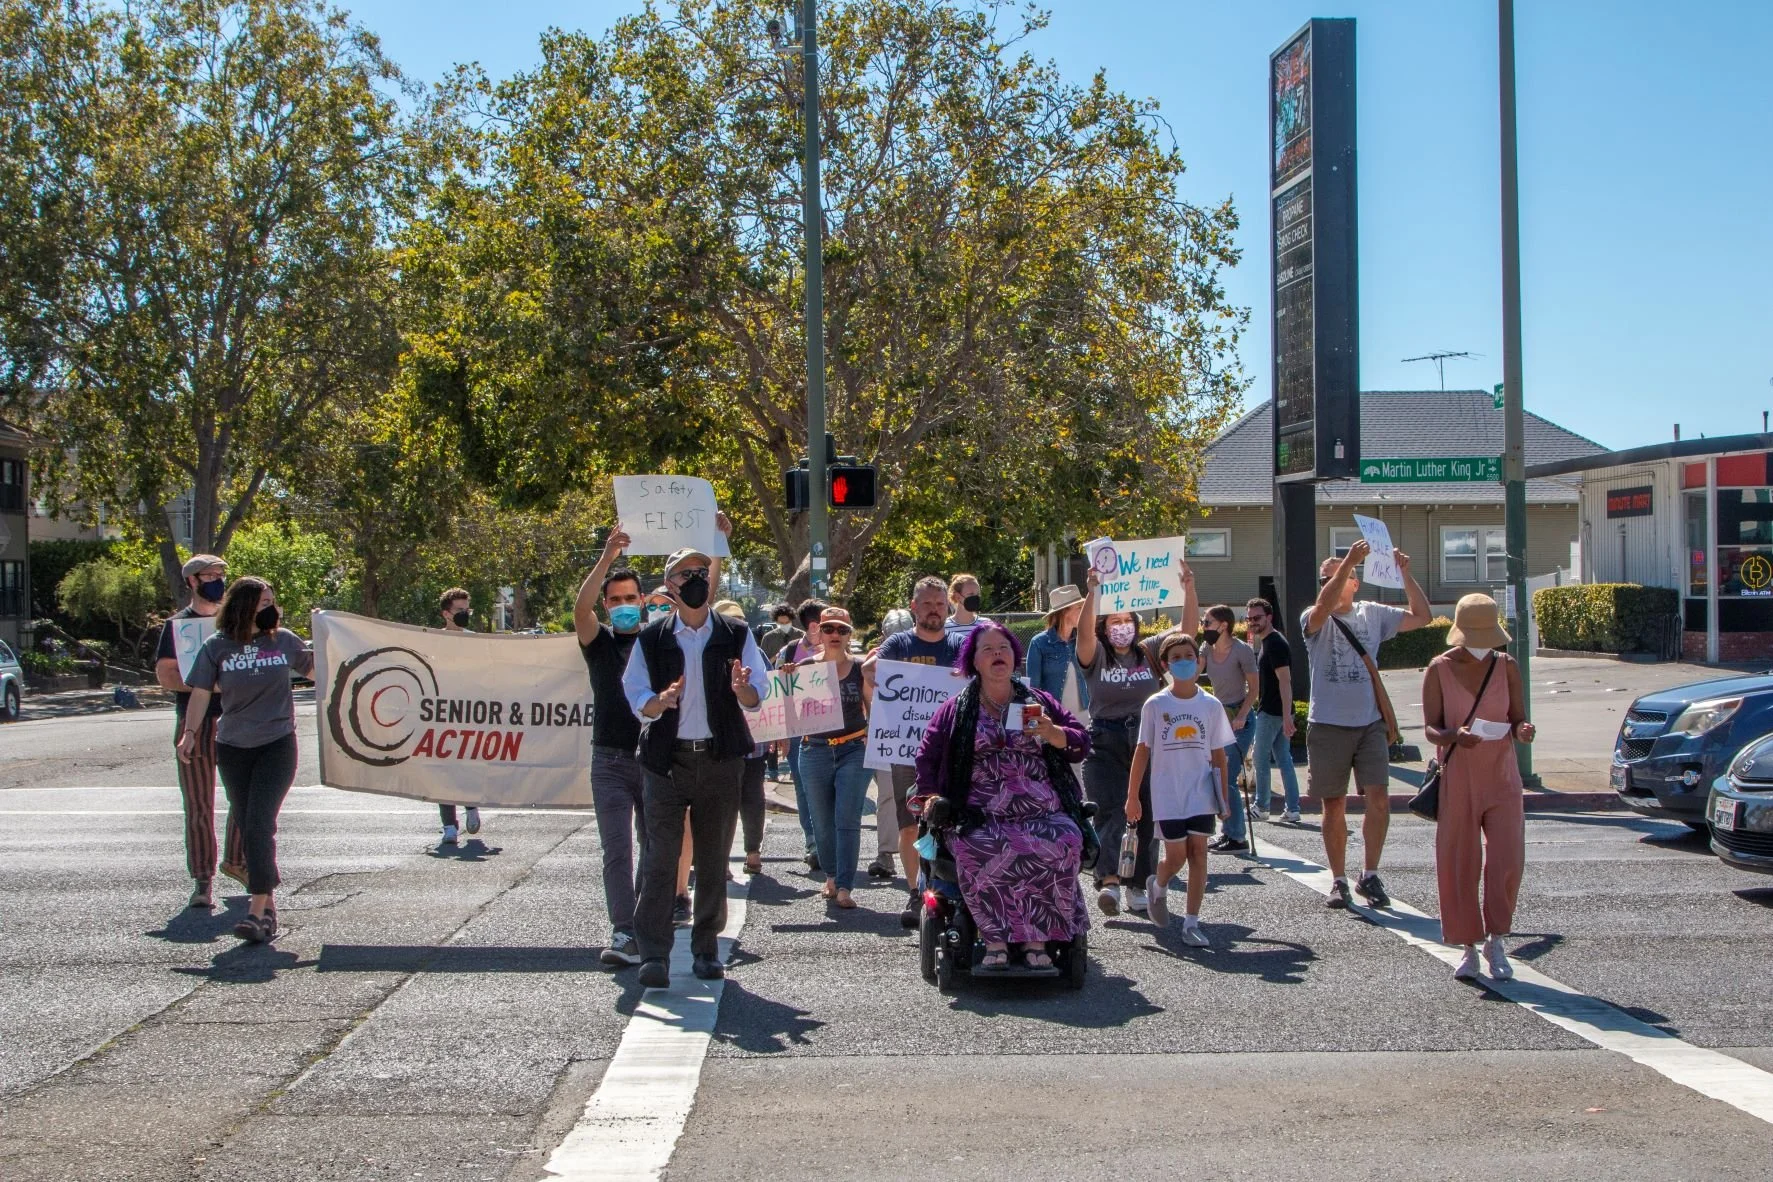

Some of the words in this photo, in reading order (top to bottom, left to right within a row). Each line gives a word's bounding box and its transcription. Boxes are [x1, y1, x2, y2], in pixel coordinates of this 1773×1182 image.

[1282, 199, 1304, 221] PROPANE
[1292, 222, 1309, 243] CHECK
[1382, 461, 1412, 478] Martin
[1416, 461, 1447, 477] Luther
[1451, 460, 1471, 481] King
[1475, 460, 1486, 477] Jr
[1486, 473, 1499, 481] 5500
[640, 480, 694, 498] Safety
[645, 508, 706, 530] FIRST
[1118, 551, 1141, 577] We
[1146, 551, 1170, 570] need
[1101, 580, 1130, 596] more
[1139, 575, 1160, 592] time
[1114, 595, 1125, 611] to
[231, 652, 257, 662] Your
[243, 645, 259, 654] Be
[222, 654, 288, 672] Normal
[809, 671, 828, 688] for
[1100, 667, 1153, 683] Normal
[878, 673, 949, 704] Seniors
[419, 698, 503, 725] SENIOR
[509, 701, 524, 726] &
[745, 703, 785, 730] SAFE
[875, 724, 901, 739] need
[1162, 726, 1170, 740] CAL
[1167, 713, 1193, 726] YOUTH
[1193, 716, 1206, 740] CAMPS
[412, 728, 524, 762] ACTION
[877, 742, 893, 757] to
